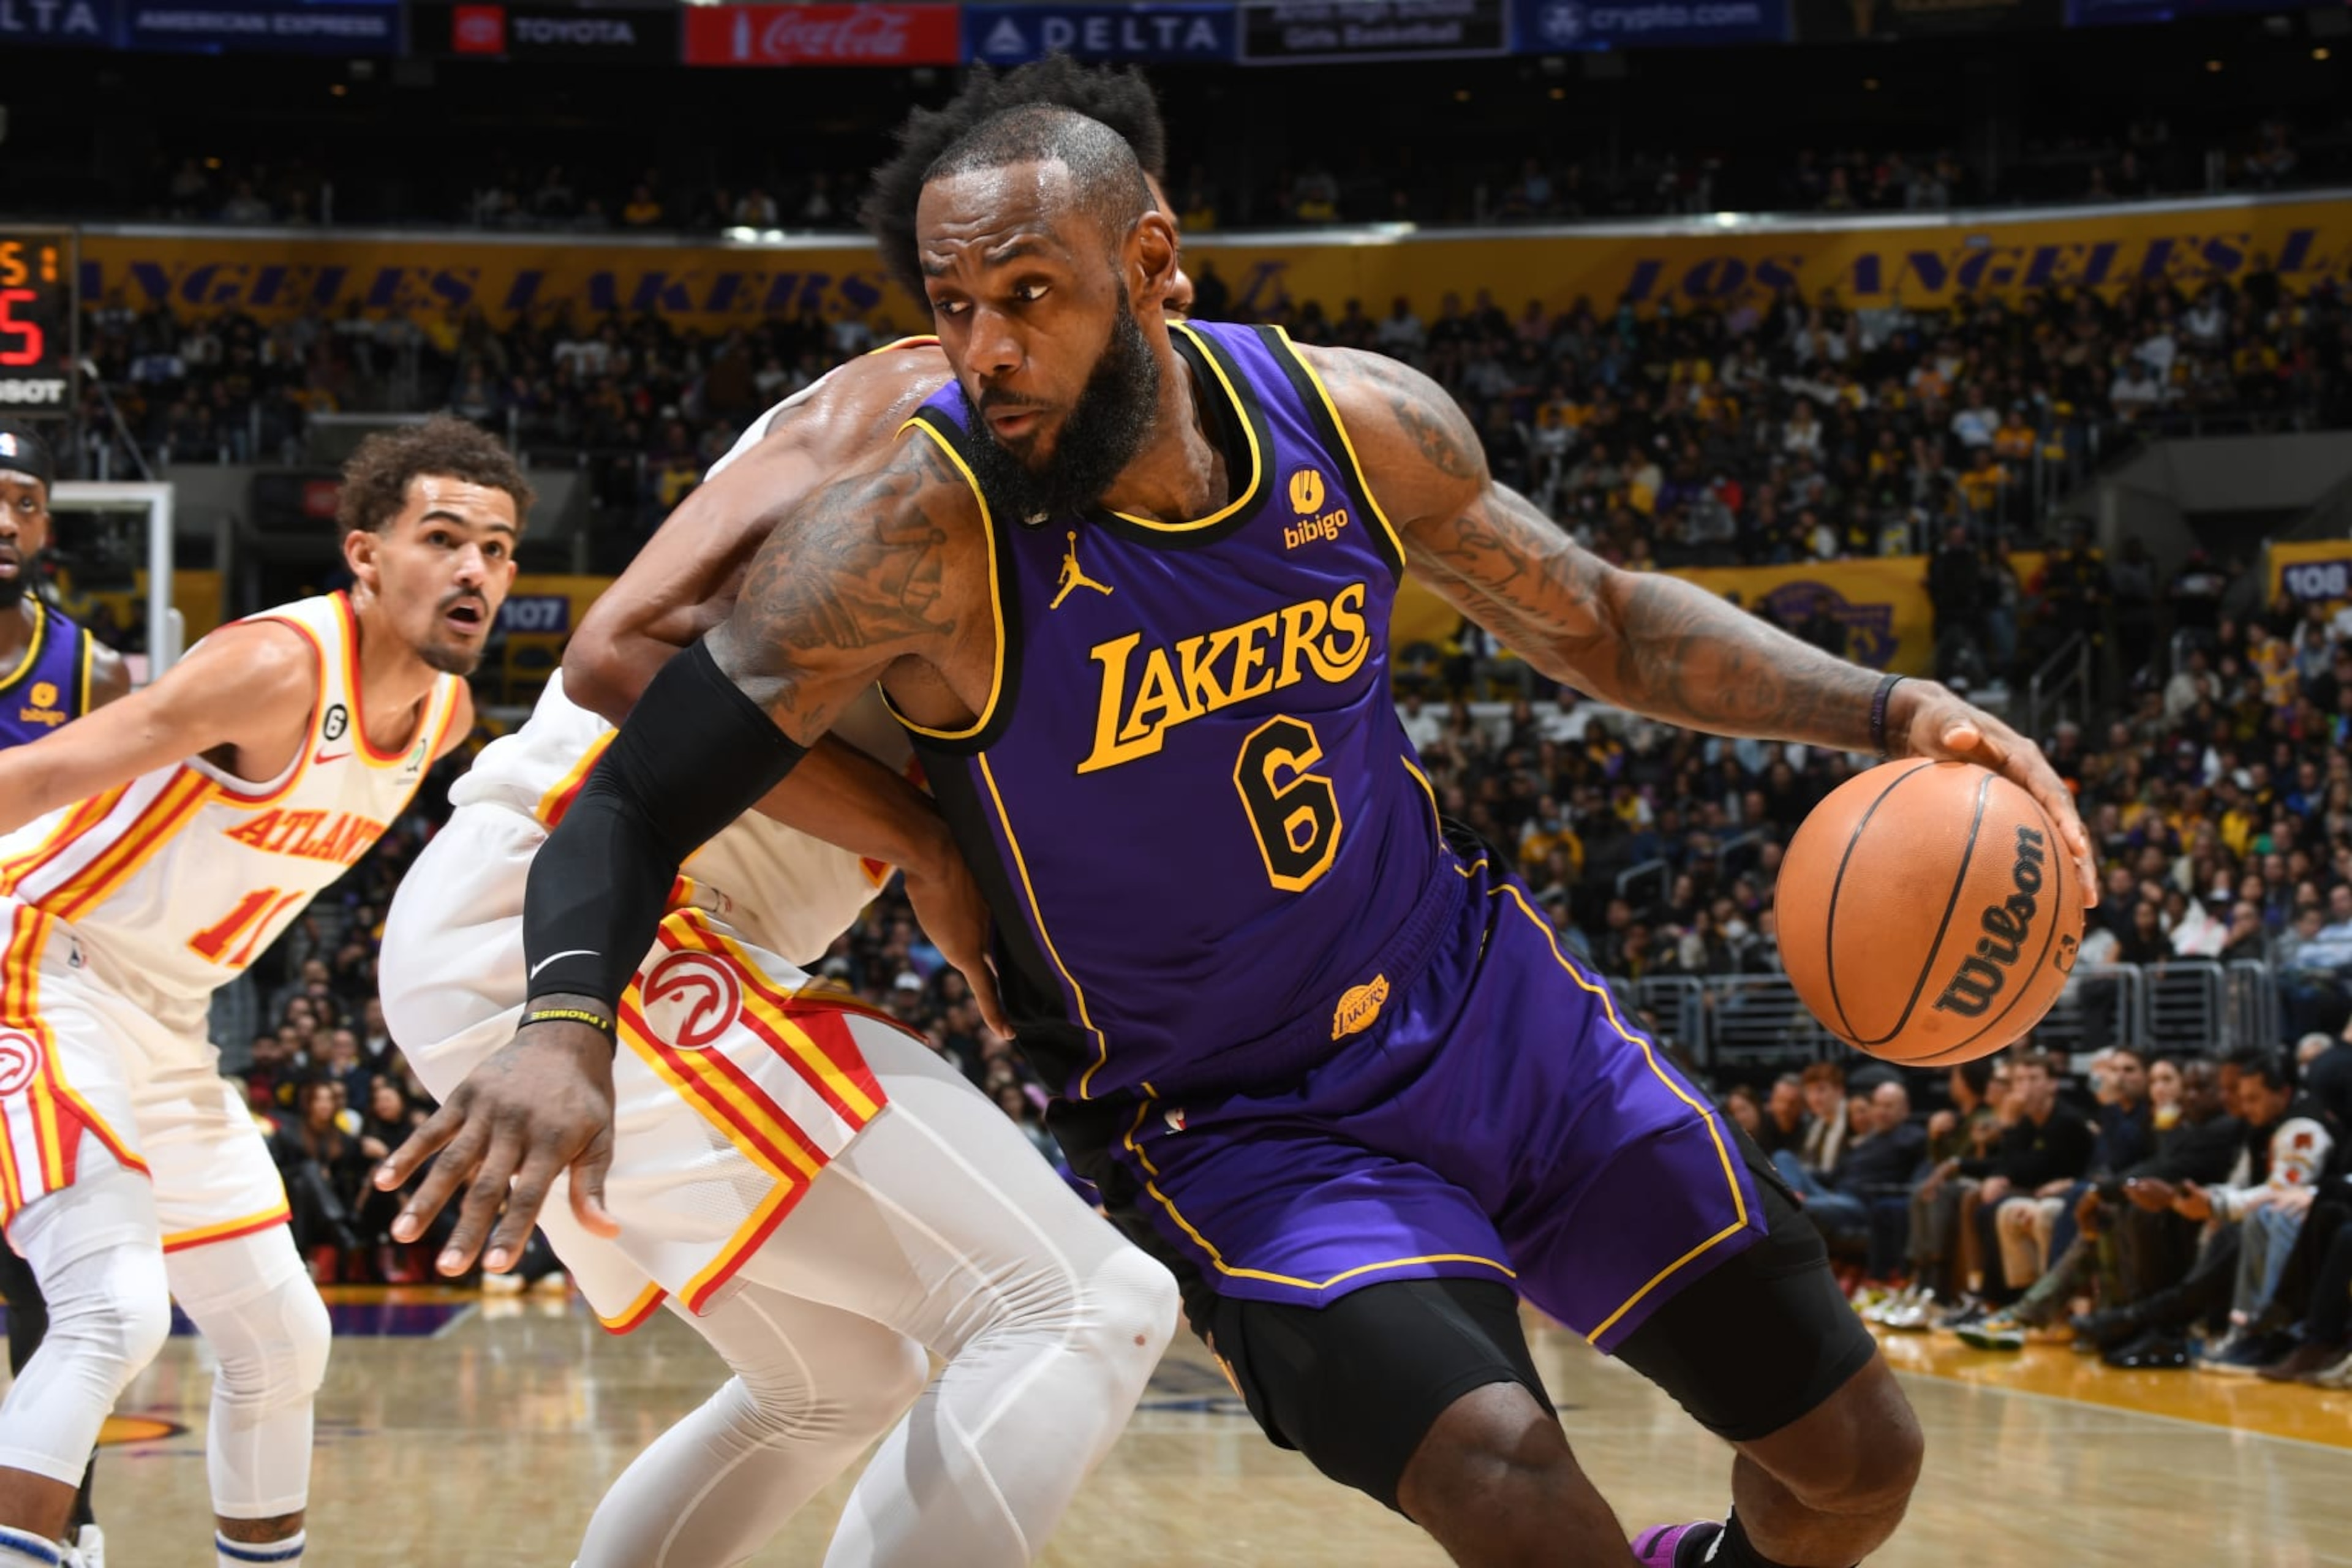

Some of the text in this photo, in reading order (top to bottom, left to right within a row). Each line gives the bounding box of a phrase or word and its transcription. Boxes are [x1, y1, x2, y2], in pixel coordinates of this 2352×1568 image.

[137, 9, 388, 36] AMERICAN EXPRESS
[513, 17, 636, 45] TOYOTA
[1043, 17, 1219, 51] DELTA
[1591, 2, 1761, 32] crypto.com
[1624, 254, 1806, 301] LOS
[1840, 234, 2251, 294] ANGELES
[503, 270, 888, 315] LAKERS
[1284, 508, 1348, 549] bibigo
[502, 597, 562, 630] 107
[1077, 582, 1370, 774] LAKERS
[323, 703, 348, 742] 6
[1233, 714, 1343, 892] 6
[1931, 824, 2045, 1018] Wilson
[530, 1009, 599, 1025] PROMISE
